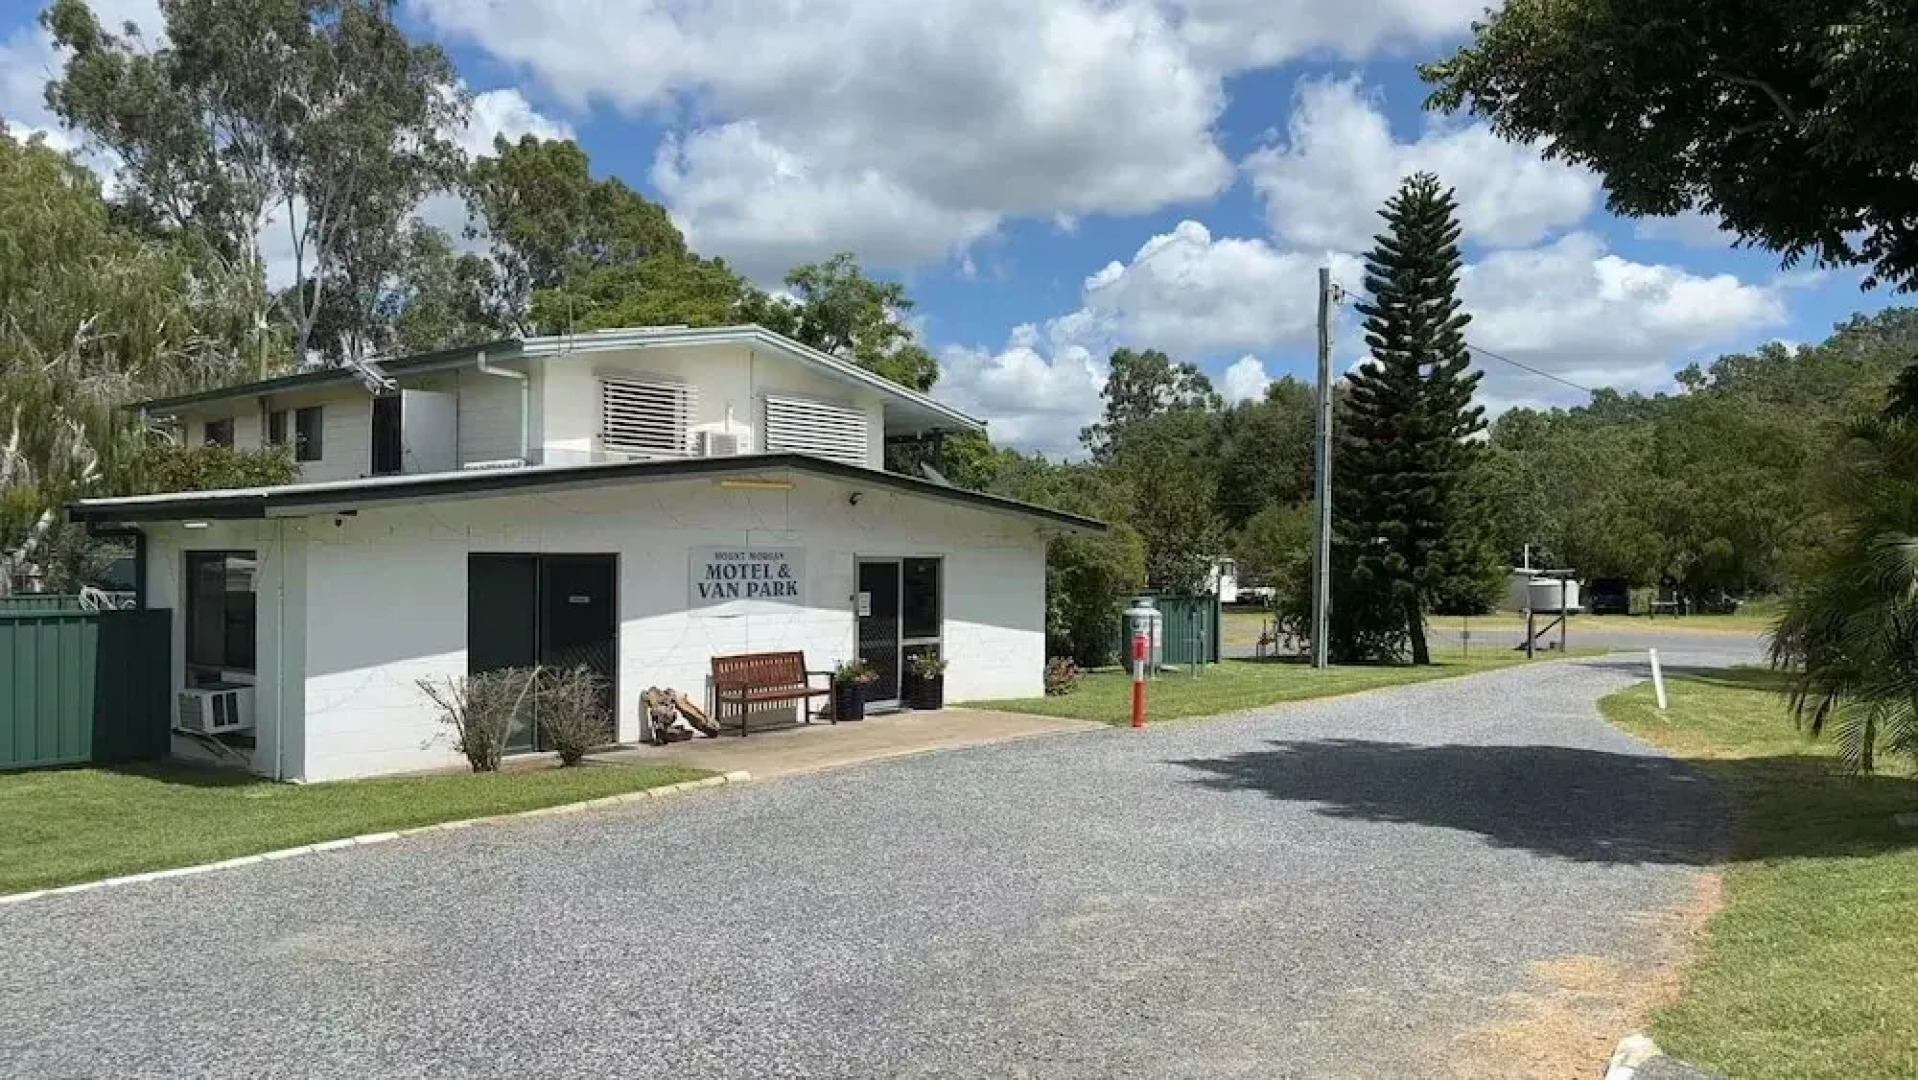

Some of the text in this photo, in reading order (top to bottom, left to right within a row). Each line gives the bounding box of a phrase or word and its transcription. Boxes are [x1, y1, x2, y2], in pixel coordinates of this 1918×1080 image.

[705, 564, 791, 579] MOTEL &
[697, 581, 798, 599] VAN PARK
